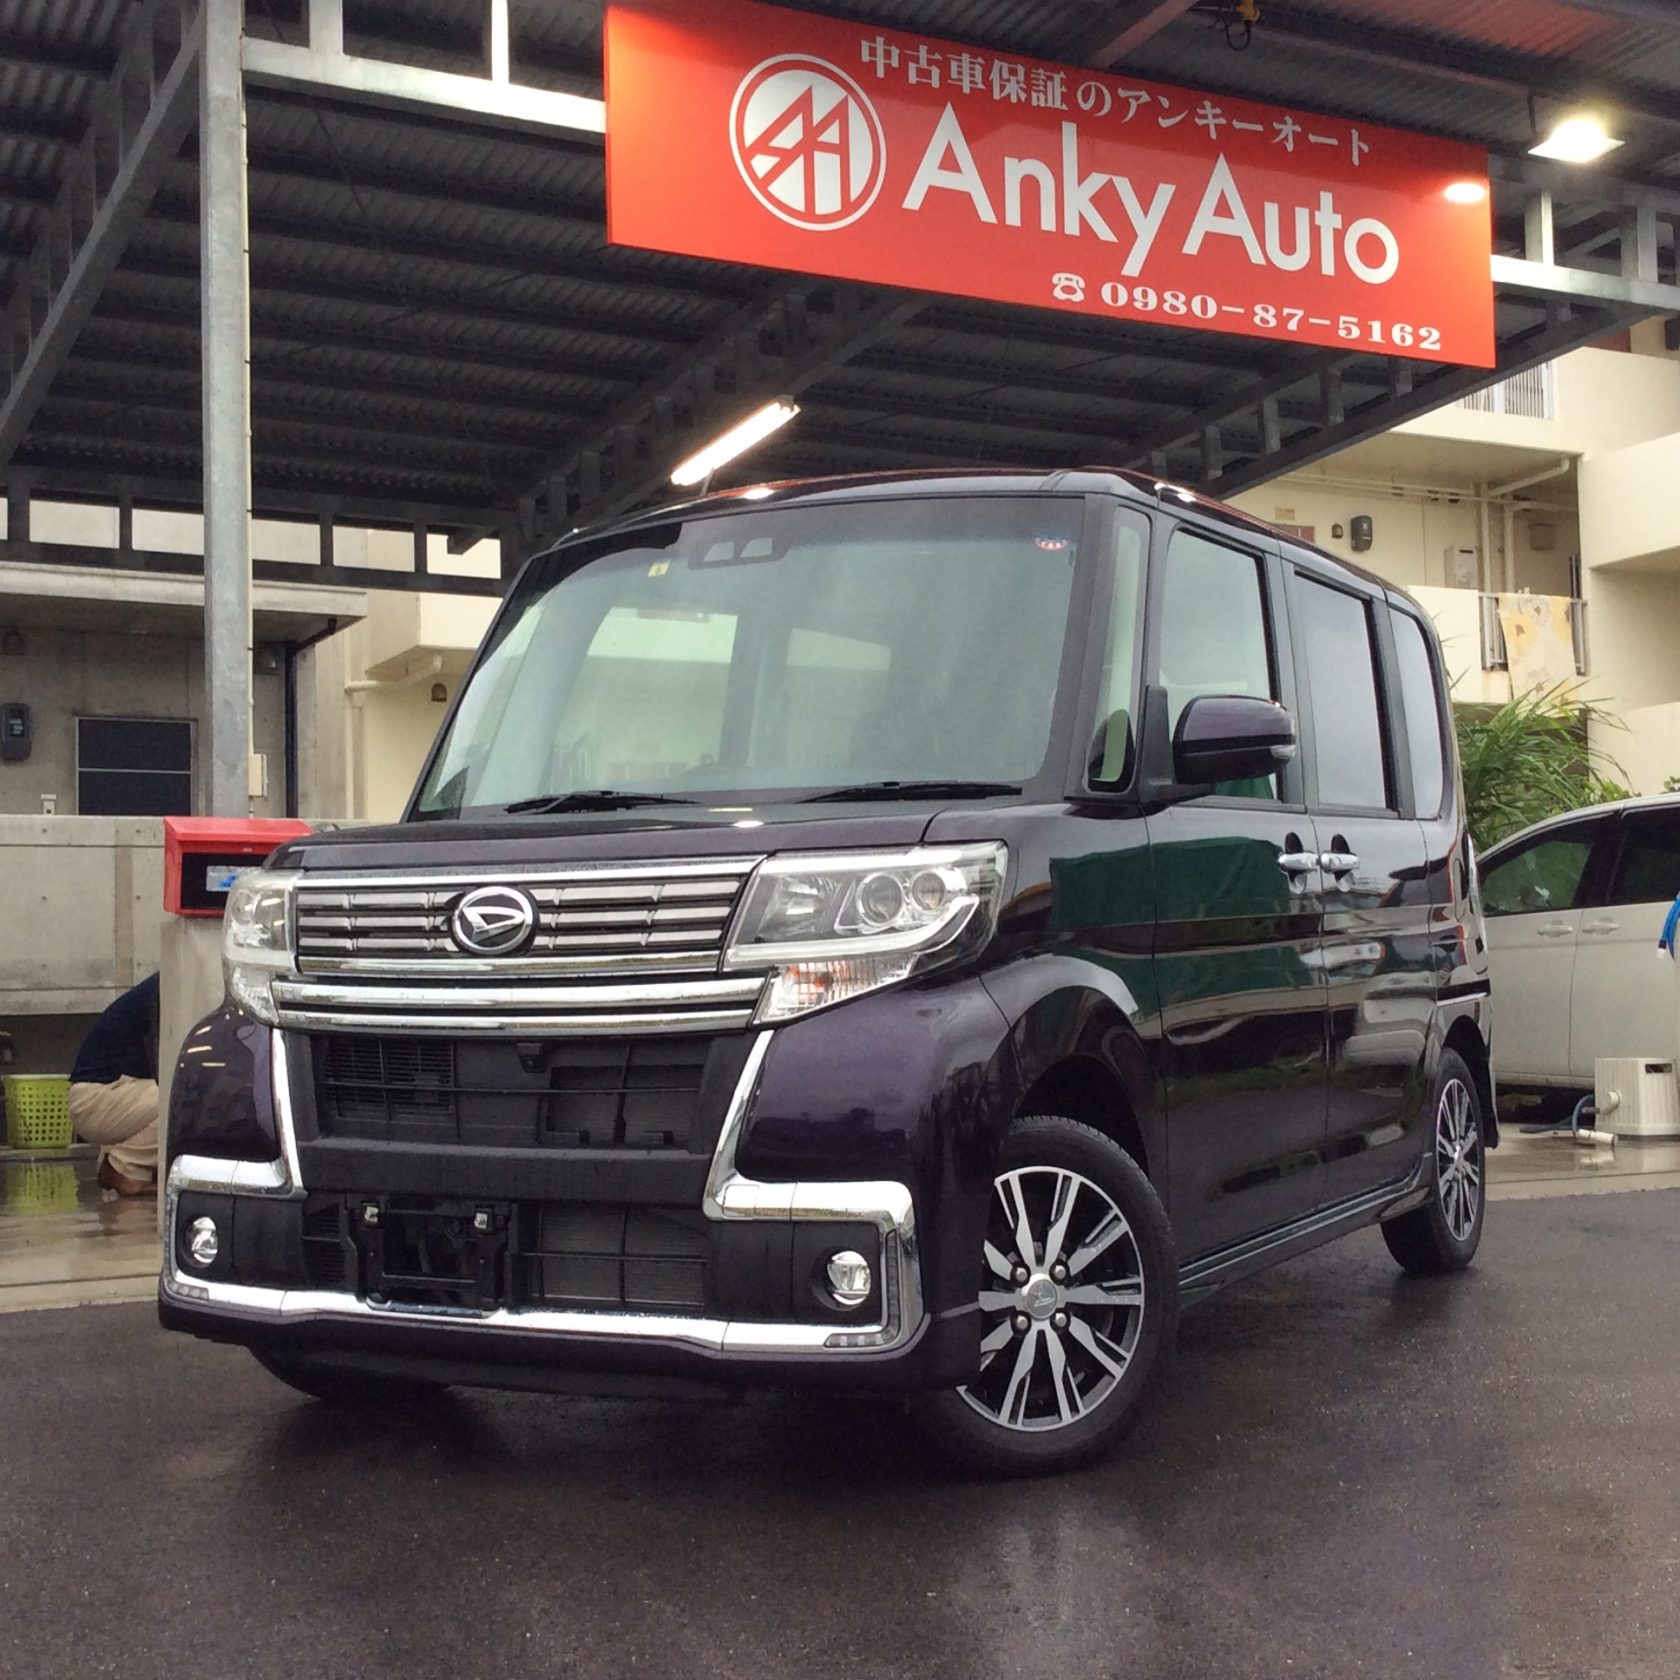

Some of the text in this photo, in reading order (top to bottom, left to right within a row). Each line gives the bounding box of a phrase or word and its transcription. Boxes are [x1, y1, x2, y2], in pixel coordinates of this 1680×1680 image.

[902, 101, 1400, 285] Anky Auto
[1100, 281, 1442, 351] 0980-87-5162
